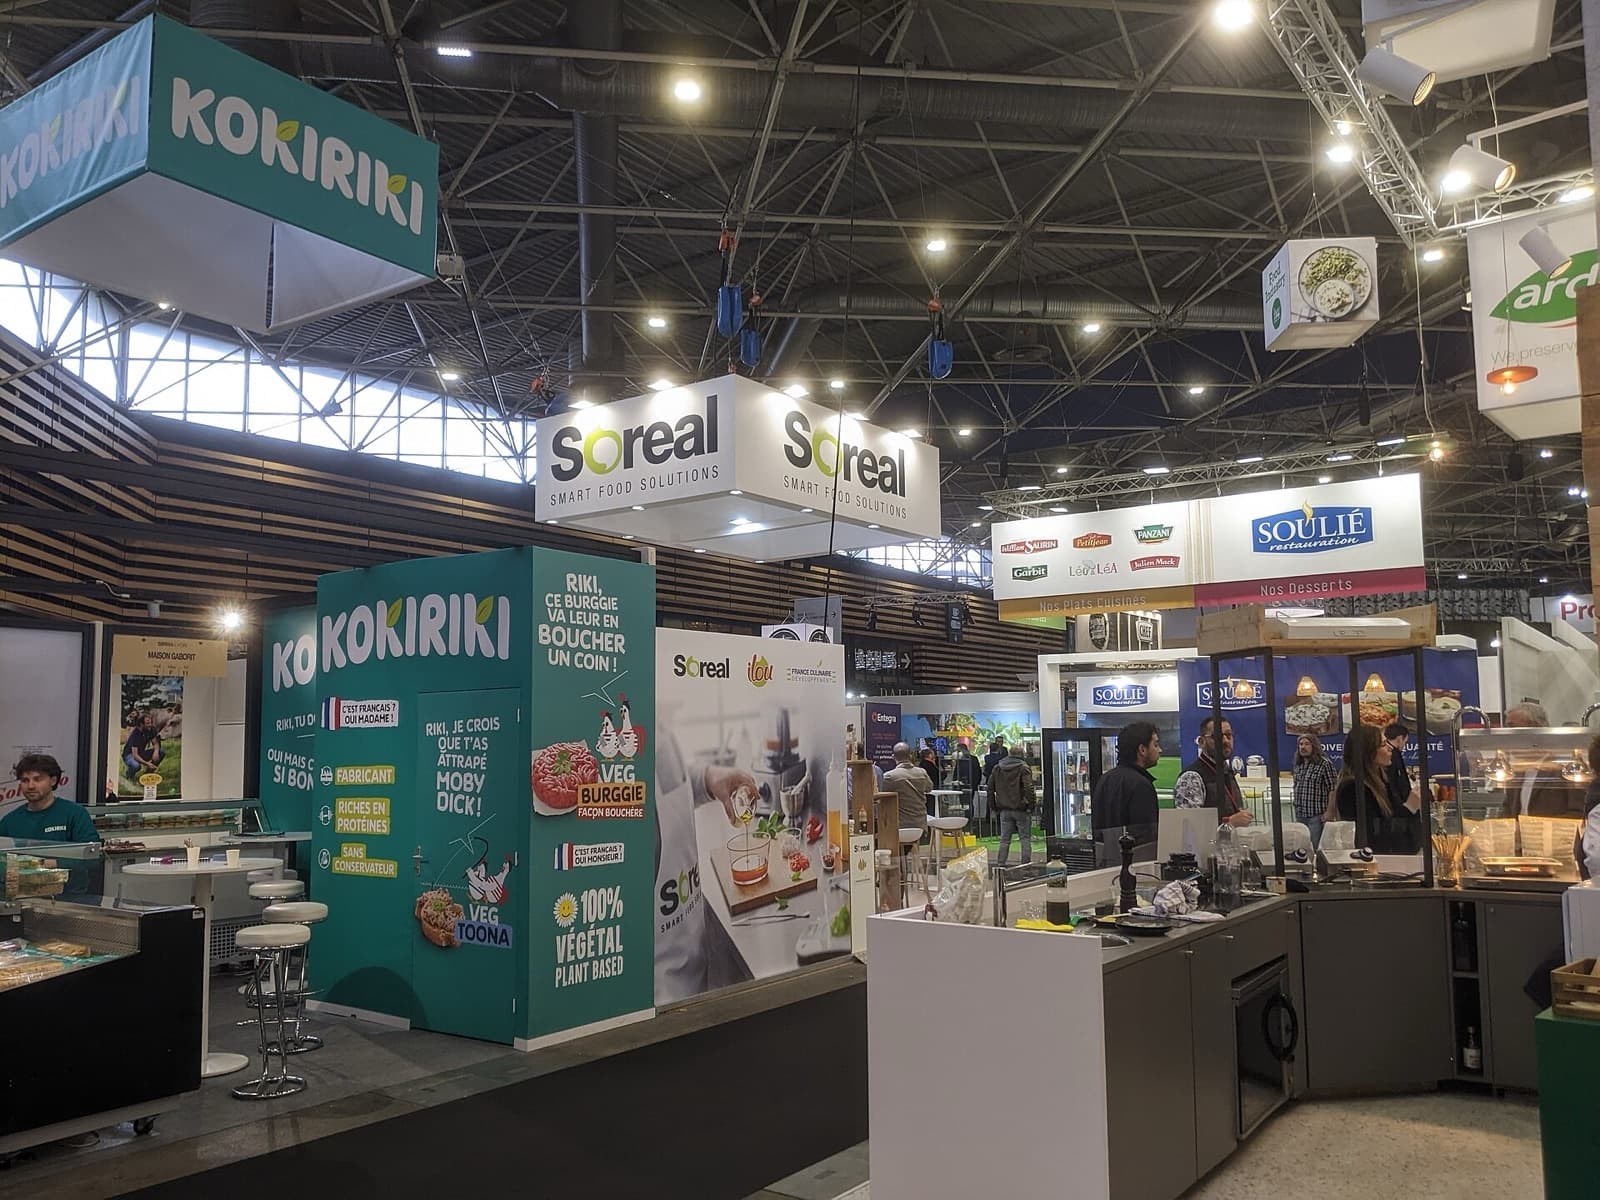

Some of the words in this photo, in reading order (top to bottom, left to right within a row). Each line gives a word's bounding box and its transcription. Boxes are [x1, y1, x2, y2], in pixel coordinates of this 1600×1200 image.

[0, 75, 140, 209] KOKIRIKI
[171, 77, 424, 235] KOKIRIKI
[550, 394, 718, 482] Soreal
[783, 410, 906, 498] Soreal
[550, 489, 591, 506] SMART
[599, 482, 633, 499] FOOD
[640, 465, 719, 491] SOLUTIONS
[783, 475, 819, 497] SMART
[824, 487, 851, 505] FOOD
[856, 498, 907, 519] SOLUTIONS
[1138, 529, 1171, 539] PANZANI
[1258, 508, 1366, 543] SOULIÉ
[1270, 536, 1359, 551] restauration
[1156, 558, 1175, 566] Mack
[1014, 567, 1046, 577] Garbit
[566, 573, 602, 596] RIKI,
[1260, 585, 1284, 596] Nos
[1289, 579, 1353, 594] Desserts
[545, 593, 561, 608] CE
[564, 595, 618, 611] BURGGIE
[1040, 602, 1060, 612] Nos
[1063, 599, 1093, 611] Plats
[1097, 595, 1147, 608] Cuisinés
[547, 608, 566, 623] VA
[569, 609, 600, 627] LEUR
[603, 614, 619, 629] EN
[322, 593, 510, 673] KOKIRIKI
[538, 623, 626, 654] BOUCHER
[148, 651, 170, 660] MAISON
[548, 648, 570, 667] UN
[574, 653, 609, 672] COIN
[673, 654, 730, 679] Soreal
[747, 654, 773, 682] ilou
[791, 668, 809, 676] FRANCE
[1095, 687, 1145, 701] SOULIÉ
[342, 705, 358, 713] C'EST
[392, 703, 396, 711] ?
[276, 718, 294, 732] RIKI,
[294, 715, 306, 728] TU
[345, 715, 357, 724] OUI
[358, 714, 389, 724] MADAME
[425, 721, 448, 736] RIKI,
[452, 720, 464, 734] JE
[466, 717, 500, 732] CROIS
[438, 737, 461, 753] QUE
[464, 737, 488, 750] T'AS
[1320, 743, 1344, 752] DIVE
[267, 748, 283, 763] OUI
[284, 752, 306, 769] MAIS
[437, 752, 487, 770] ATTRAPÉ
[273, 764, 285, 784] SI
[337, 771, 392, 784] FABRICANT
[436, 771, 485, 794] MOBY
[601, 764, 635, 784] VEG
[436, 791, 475, 816] DICK
[581, 786, 643, 804] BURGGIE
[338, 801, 370, 815] RICHES
[373, 802, 385, 815] EN
[578, 807, 604, 819] FAÇON
[606, 806, 643, 817] BOUCHÈRE
[337, 815, 387, 833] PROTÉINES
[342, 846, 364, 859] SANS
[575, 848, 589, 857] C'EST
[575, 857, 587, 865] OUI
[588, 853, 619, 863] MONSIEUR
[334, 860, 395, 875] CONSERVATEUR
[469, 903, 499, 925] VEG
[581, 885, 623, 924] 100%
[661, 913, 683, 933] SMART
[457, 922, 510, 946] TOONA
[556, 924, 623, 964] VÉGÉTAL
[555, 961, 589, 989] PLANT
[592, 956, 623, 980] BASED
